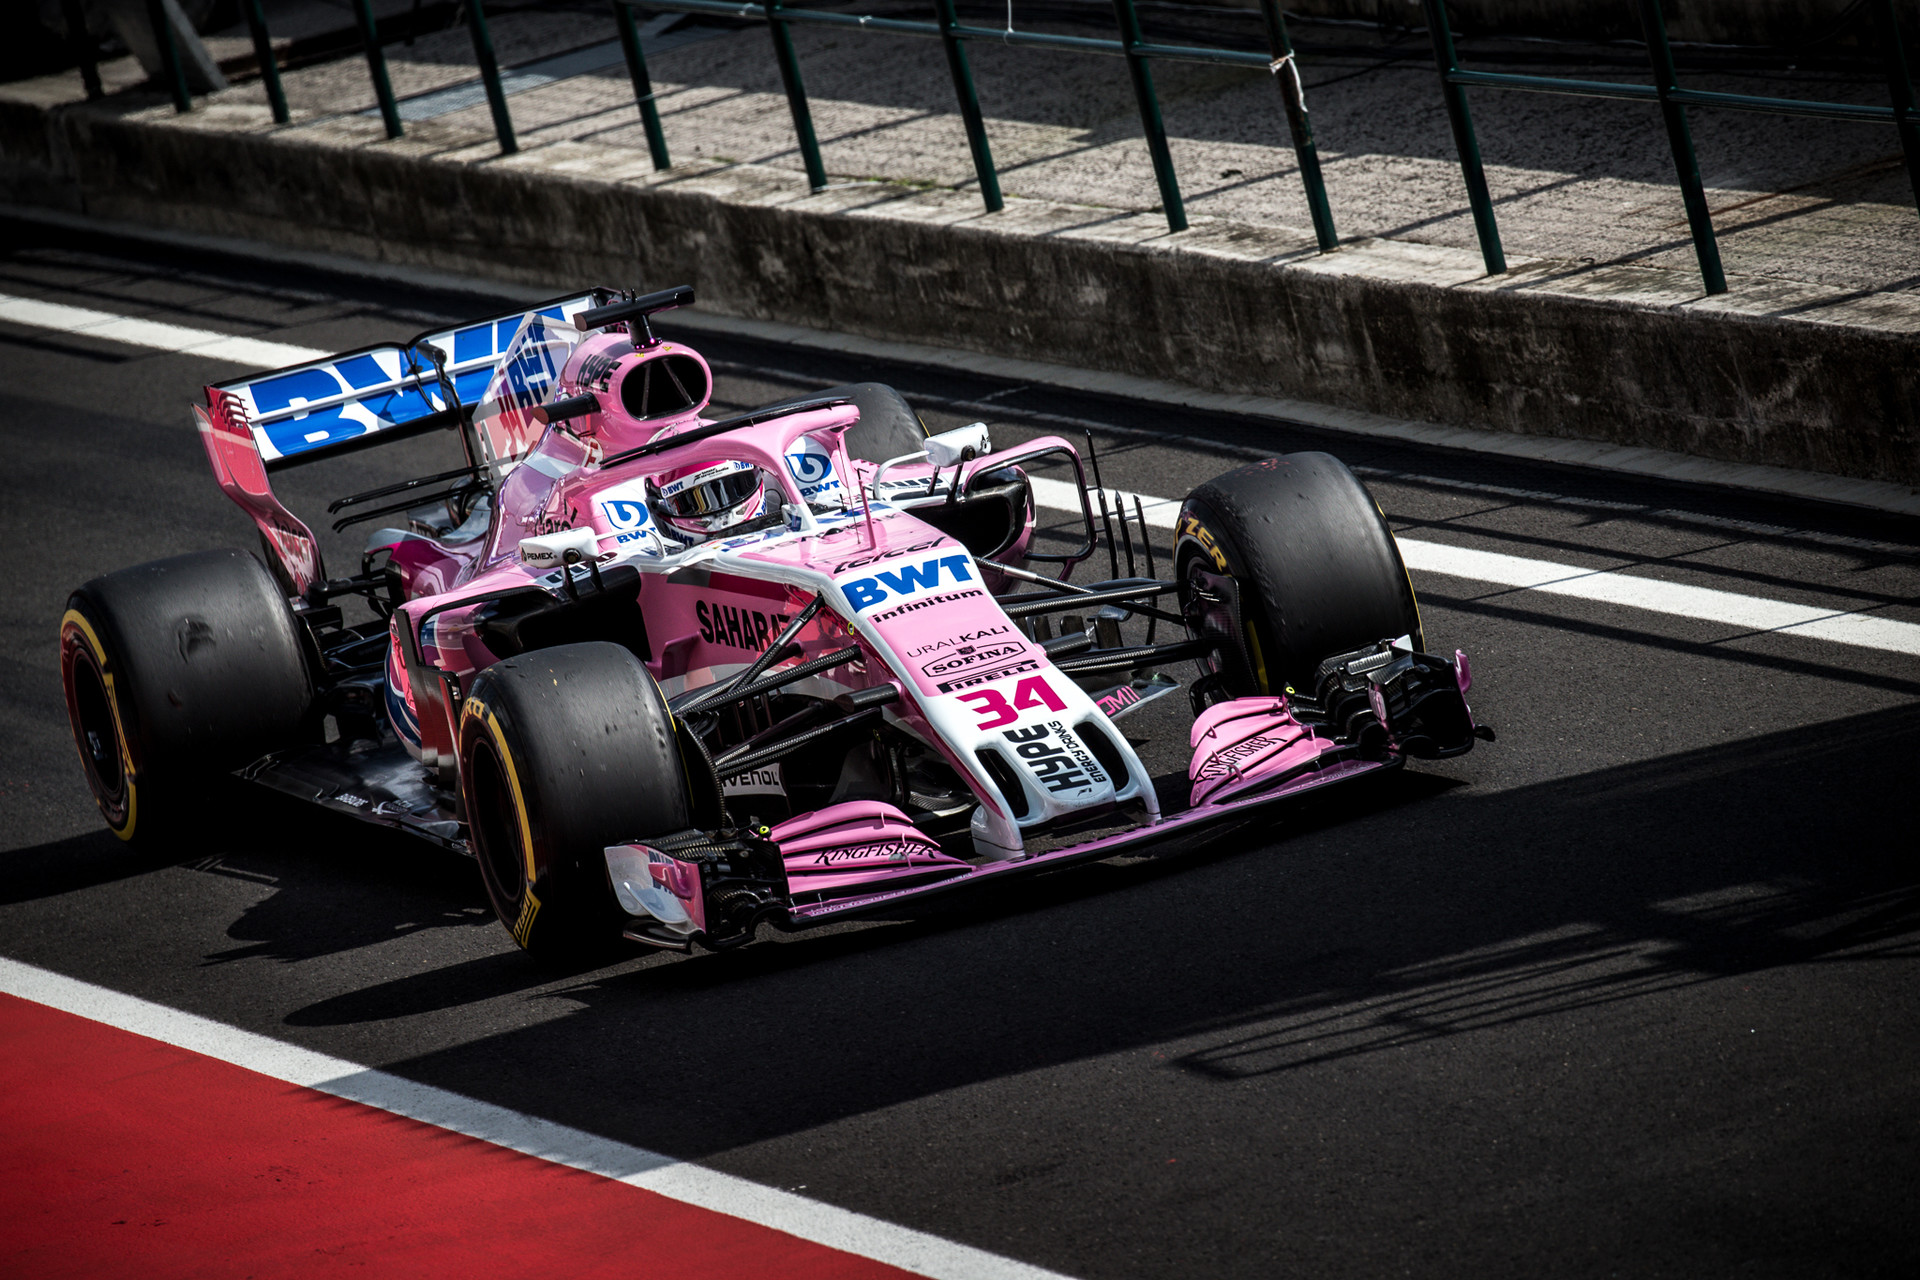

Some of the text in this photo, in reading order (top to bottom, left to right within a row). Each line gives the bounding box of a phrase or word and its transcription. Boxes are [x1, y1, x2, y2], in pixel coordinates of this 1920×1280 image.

[576, 353, 623, 393] HYPE
[667, 482, 685, 494] BWT
[800, 480, 840, 497] BWT
[526, 552, 554, 561] PEMEX
[833, 536, 947, 574] telcel
[1186, 517, 1233, 578] ZER
[841, 554, 973, 613] BWT
[873, 590, 984, 624] infinitum
[907, 625, 1010, 658] URALKALI
[932, 646, 1018, 674] SOFINA
[936, 659, 1040, 694] PIRELLI
[955, 675, 1068, 731] 34
[1002, 724, 1092, 793] HYPE
[1047, 720, 1107, 783] ENERGY DRINKS
[1195, 736, 1288, 785] KINGFISHER
[723, 770, 780, 787] VENOL
[814, 843, 936, 866] KINGFISHER
